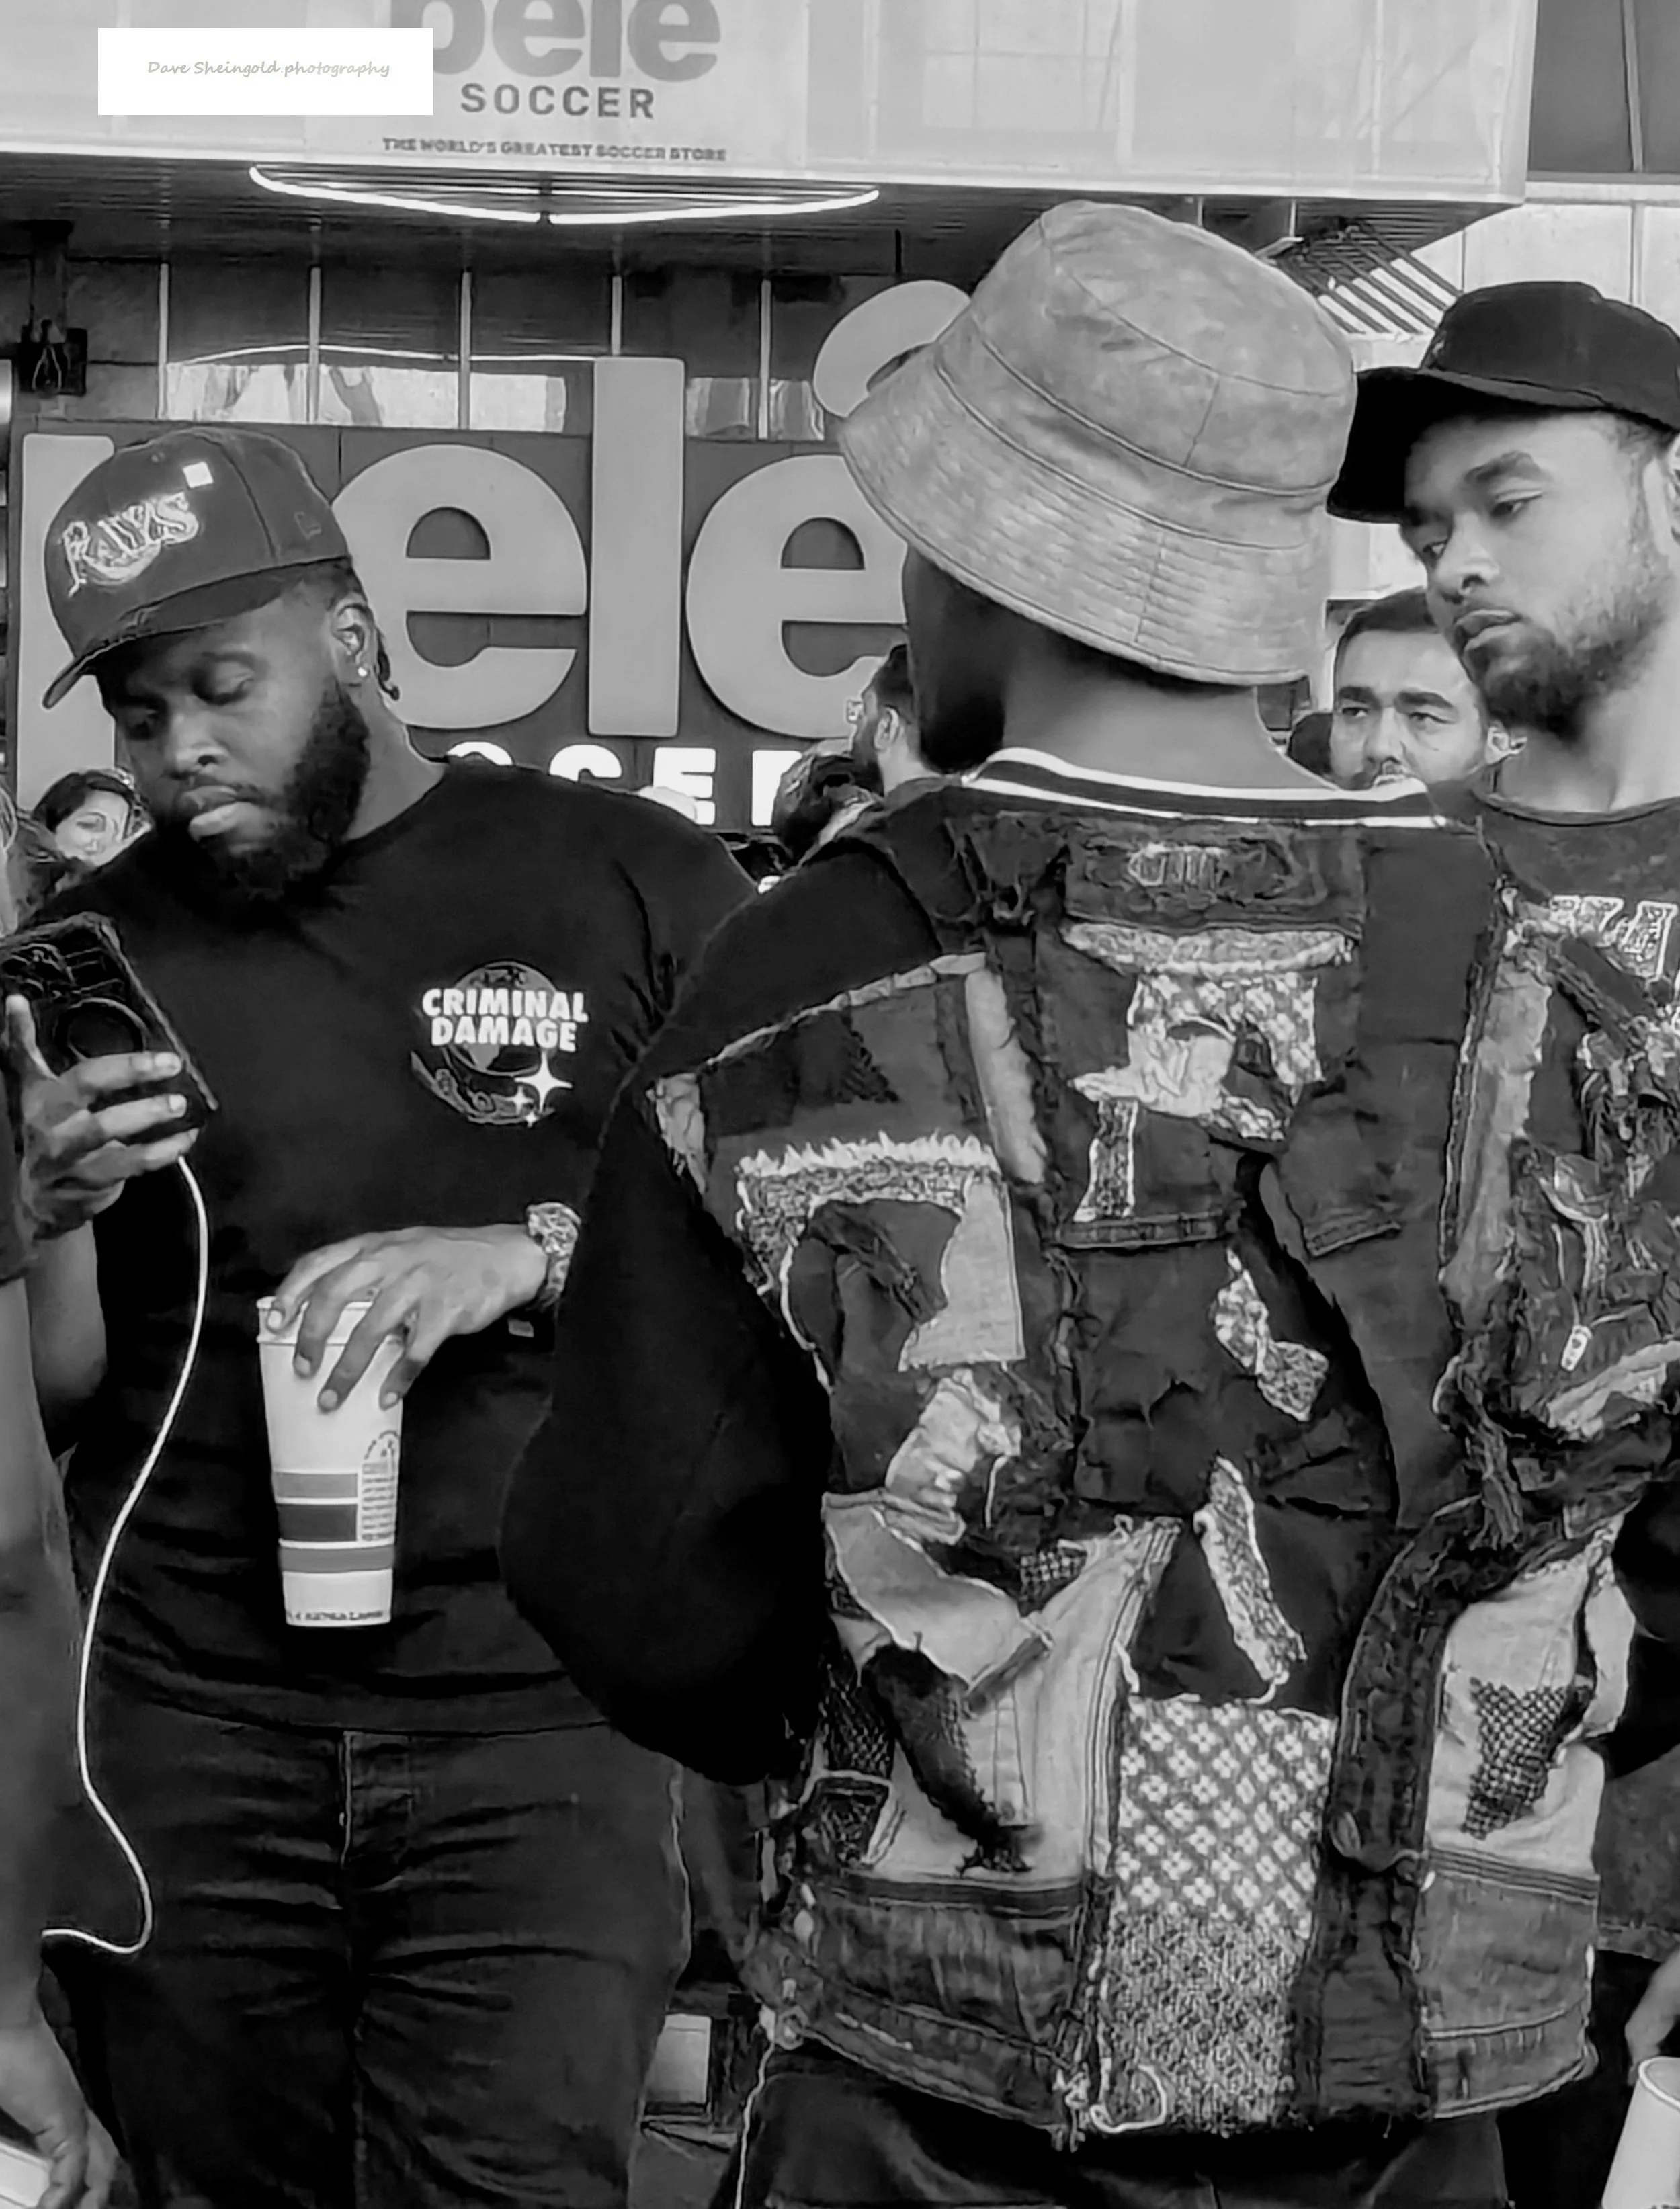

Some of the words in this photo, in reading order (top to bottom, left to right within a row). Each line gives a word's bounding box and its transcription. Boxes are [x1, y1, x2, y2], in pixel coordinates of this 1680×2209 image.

[460, 83, 655, 119] SOCCER
[382, 138, 417, 151] THE
[420, 140, 497, 153] WORLD'S
[500, 142, 592, 156] GREATEST
[596, 144, 666, 159] SOCCER
[669, 147, 726, 161] STORE
[423, 988, 589, 1023] CRIMINAL
[431, 1015, 577, 1052] DAMAGE
